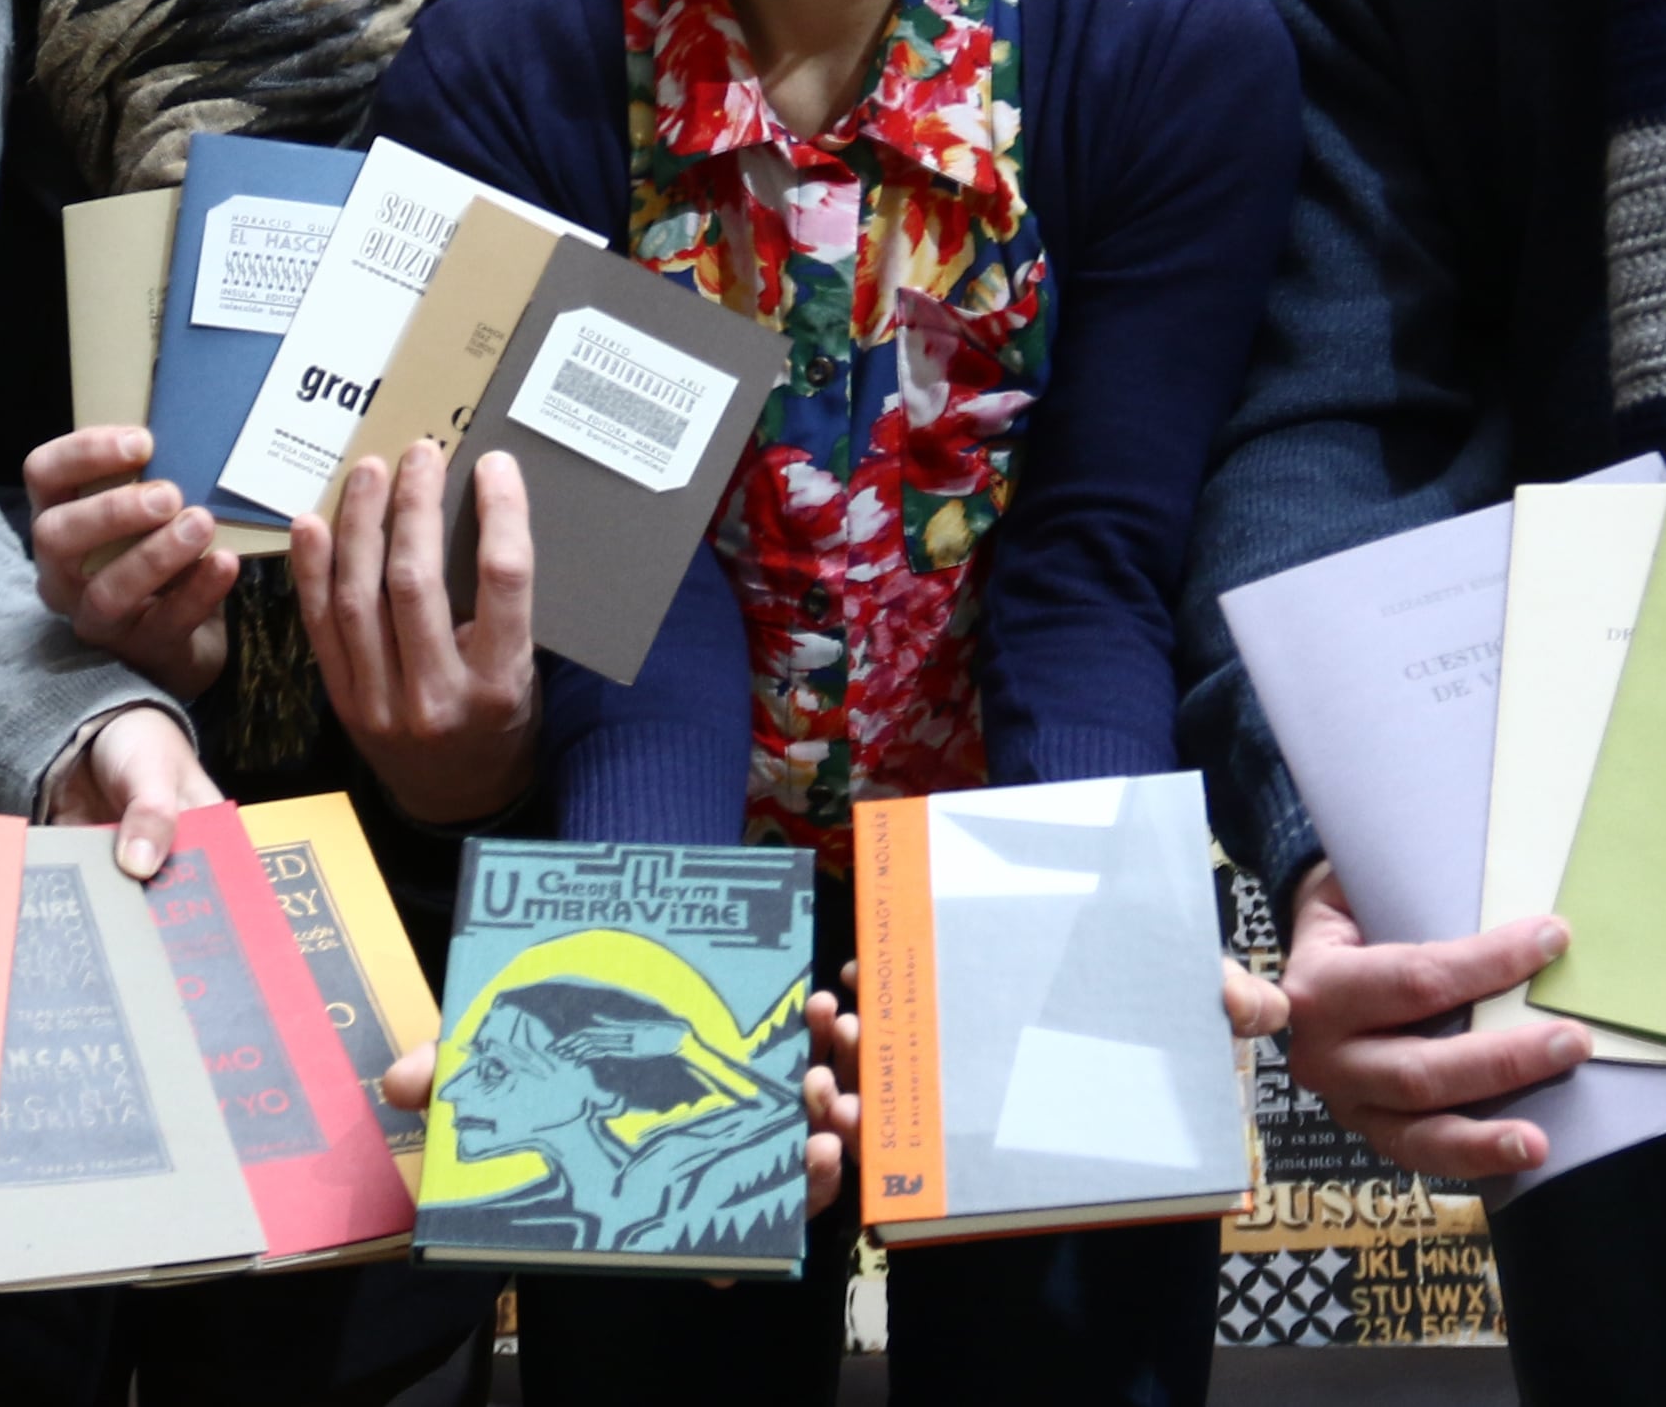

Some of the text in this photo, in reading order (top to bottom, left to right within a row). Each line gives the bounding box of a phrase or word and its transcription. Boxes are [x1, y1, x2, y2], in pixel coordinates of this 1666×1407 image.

[229, 228, 248, 246] EL
[231, 215, 292, 230] HORACIO
[580, 325, 632, 357] ROBERTO
[545, 393, 580, 416] INSULA
[586, 413, 628, 440] EDITORA
[1431, 679, 1473, 703] DE
[536, 858, 719, 903] Georg Heym
[875, 896, 894, 945] NAGY
[237, 1088, 291, 1118] YO
[878, 1043, 898, 1151] SCHLEMMER
[1349, 1152, 1370, 1170] de
[1235, 1170, 1438, 1229] BUSCA
